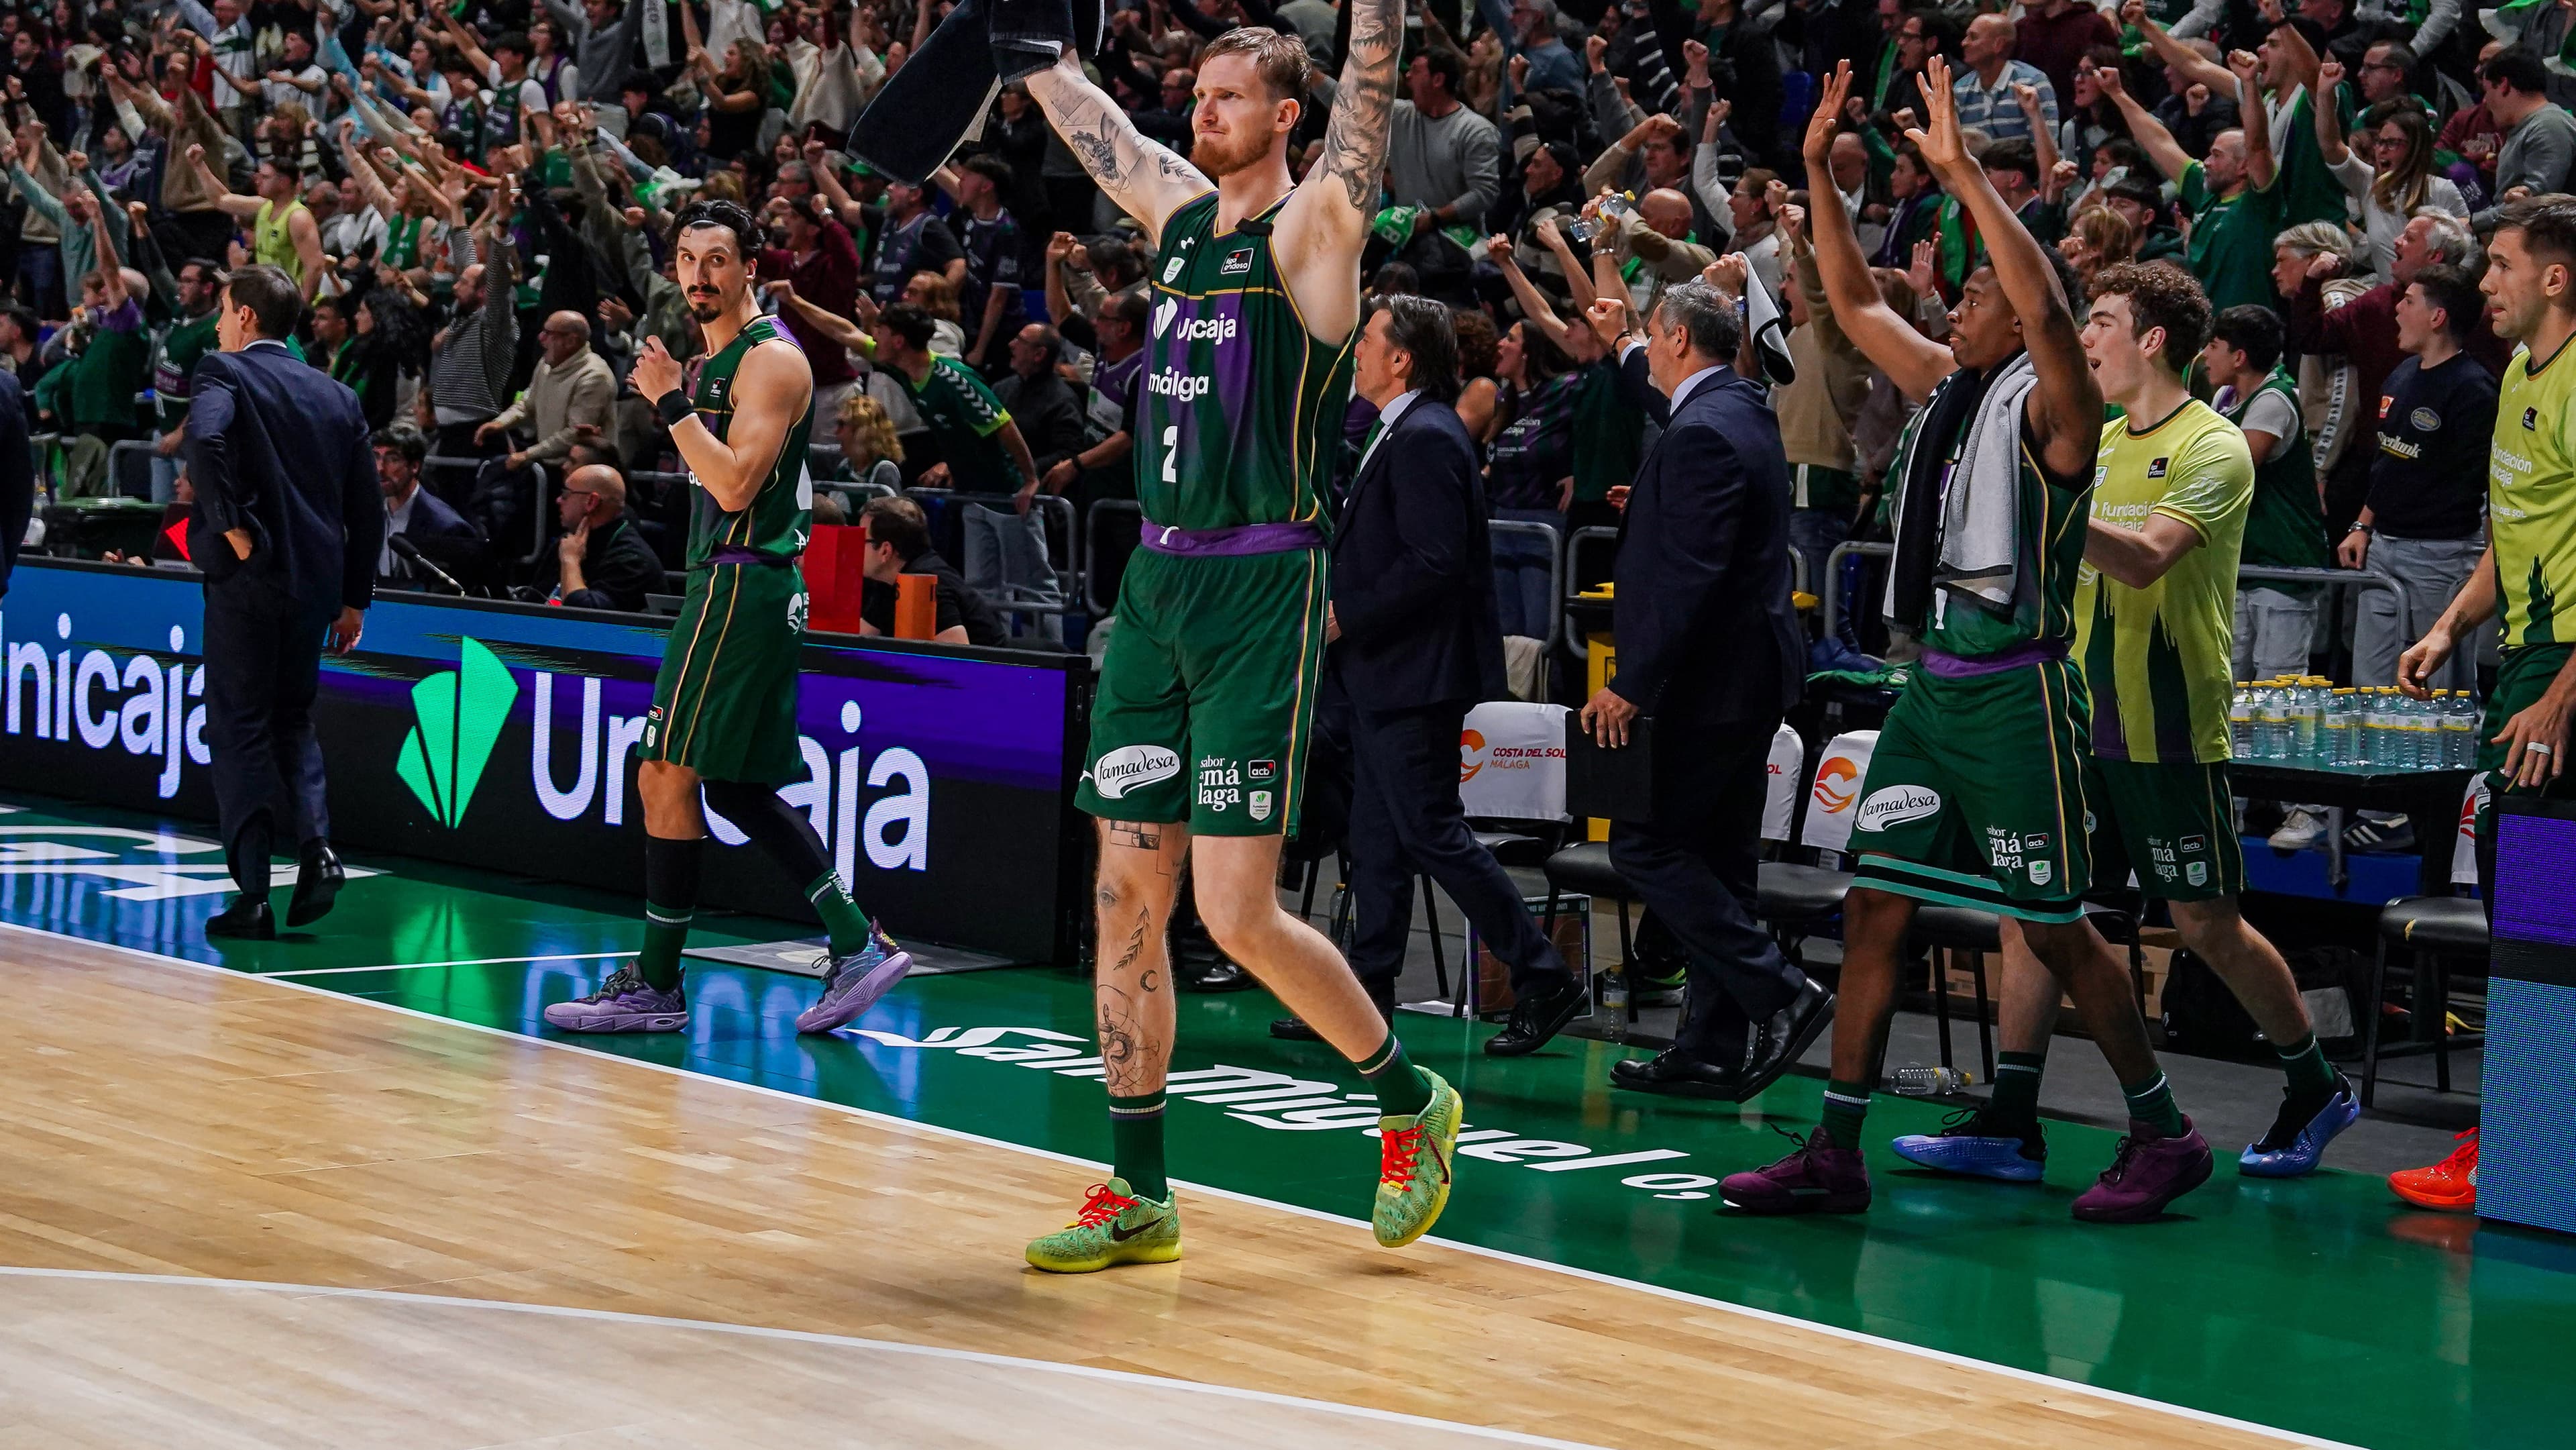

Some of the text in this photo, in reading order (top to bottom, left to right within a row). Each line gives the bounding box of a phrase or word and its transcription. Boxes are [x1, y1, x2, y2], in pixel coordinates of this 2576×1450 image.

[1163, 425, 1178, 483] 2
[0, 610, 212, 798] nicaja
[1199, 755, 1225, 768] sabor
[1493, 747, 1566, 758] COSTA DEL SOL
[1097, 749, 1176, 787] famadesa
[1251, 765, 1270, 776] acb
[1489, 758, 1530, 769] MÁLAGA
[1766, 764, 1782, 774] OL
[1197, 782, 1241, 812] laga
[1860, 788, 1937, 823] famadesa
[2154, 862, 2179, 882] aga
